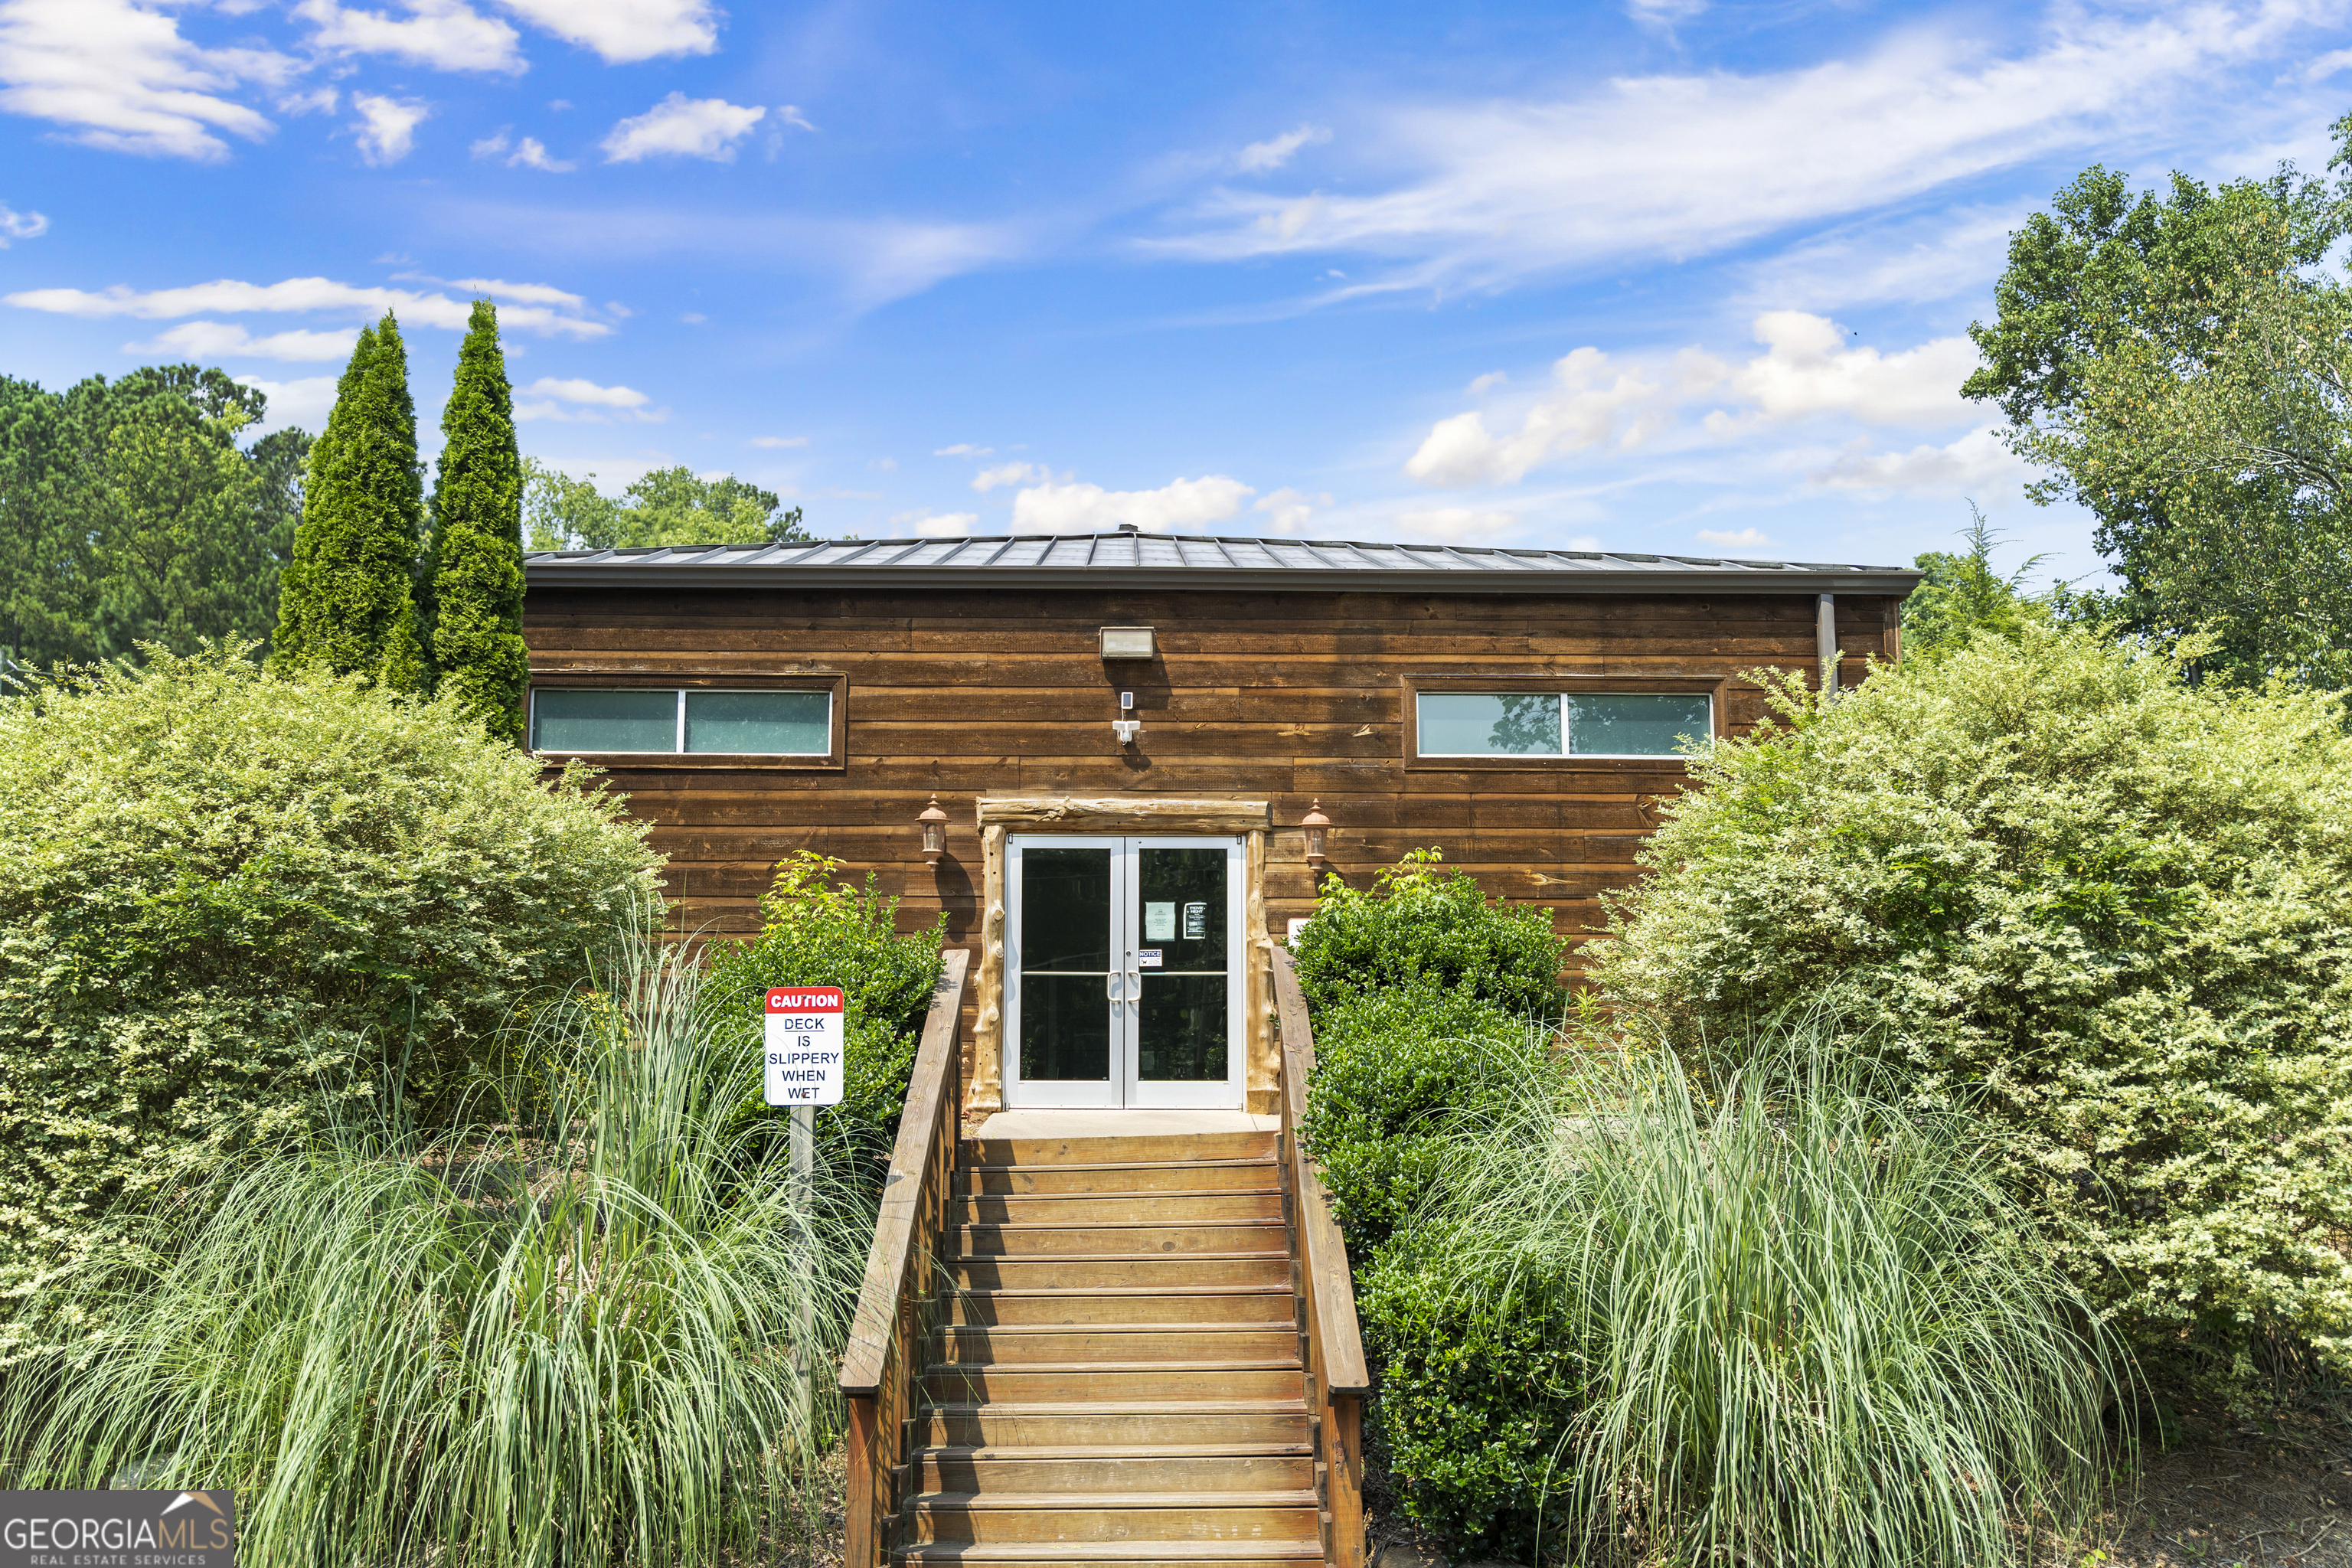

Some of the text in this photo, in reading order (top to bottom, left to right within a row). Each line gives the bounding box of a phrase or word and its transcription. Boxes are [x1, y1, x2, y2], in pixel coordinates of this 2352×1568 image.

[770, 995, 838, 1008] CAUTION
[785, 1018, 825, 1030] DECK
[798, 1036, 811, 1047] IS
[769, 1053, 839, 1064] SLIPPERY
[782, 1070, 825, 1081] WHEN
[788, 1087, 820, 1099] WET
